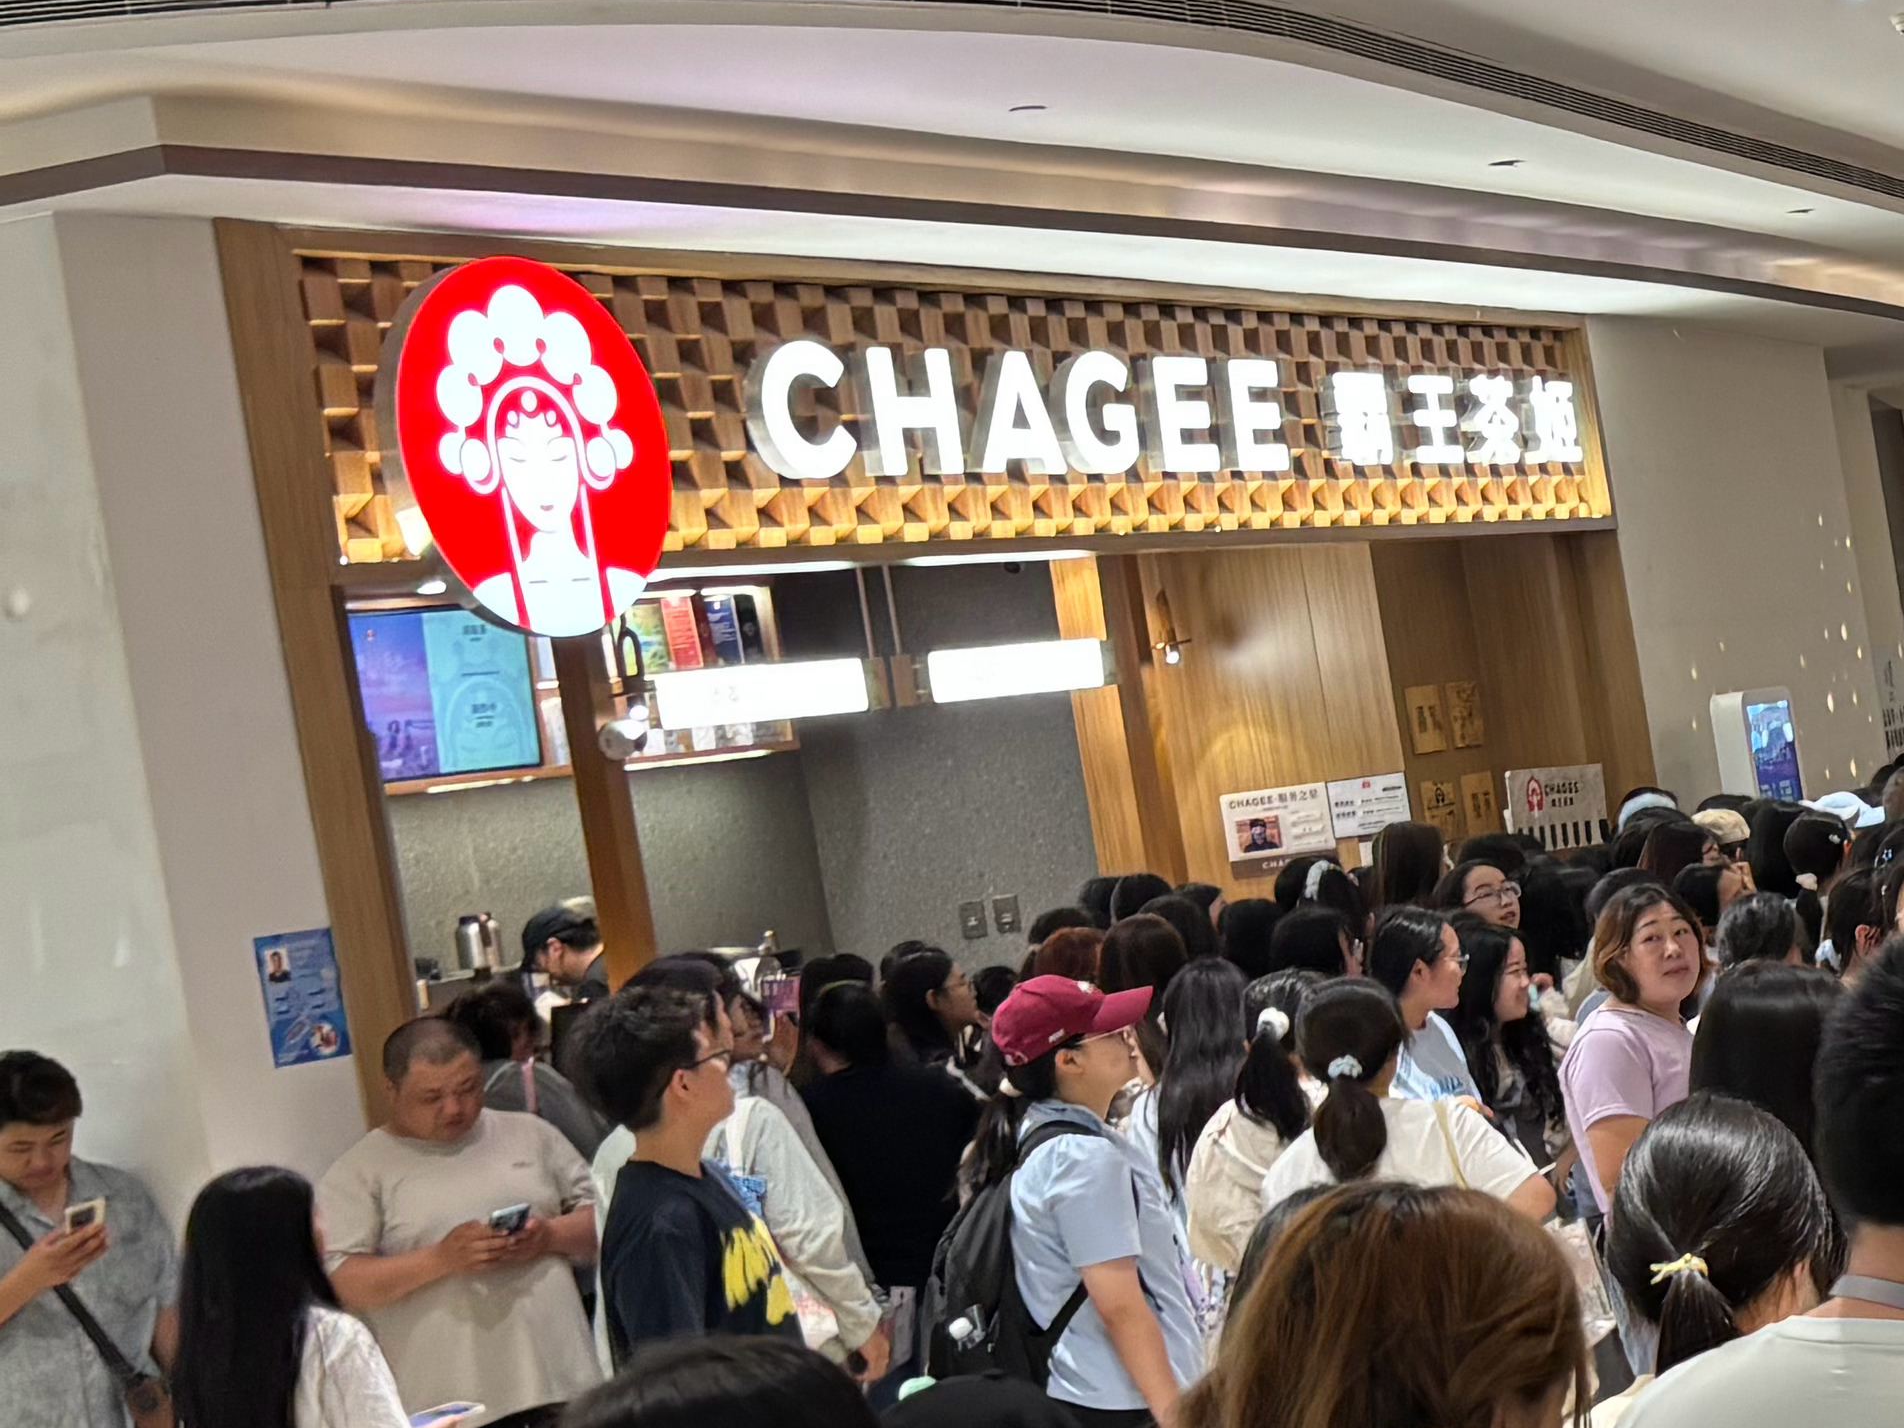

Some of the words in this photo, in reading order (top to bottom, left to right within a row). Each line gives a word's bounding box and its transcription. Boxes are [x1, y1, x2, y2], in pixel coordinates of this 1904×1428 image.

[755, 340, 1290, 480] CHAGEE
[1333, 370, 1584, 467] 霸王茶姬
